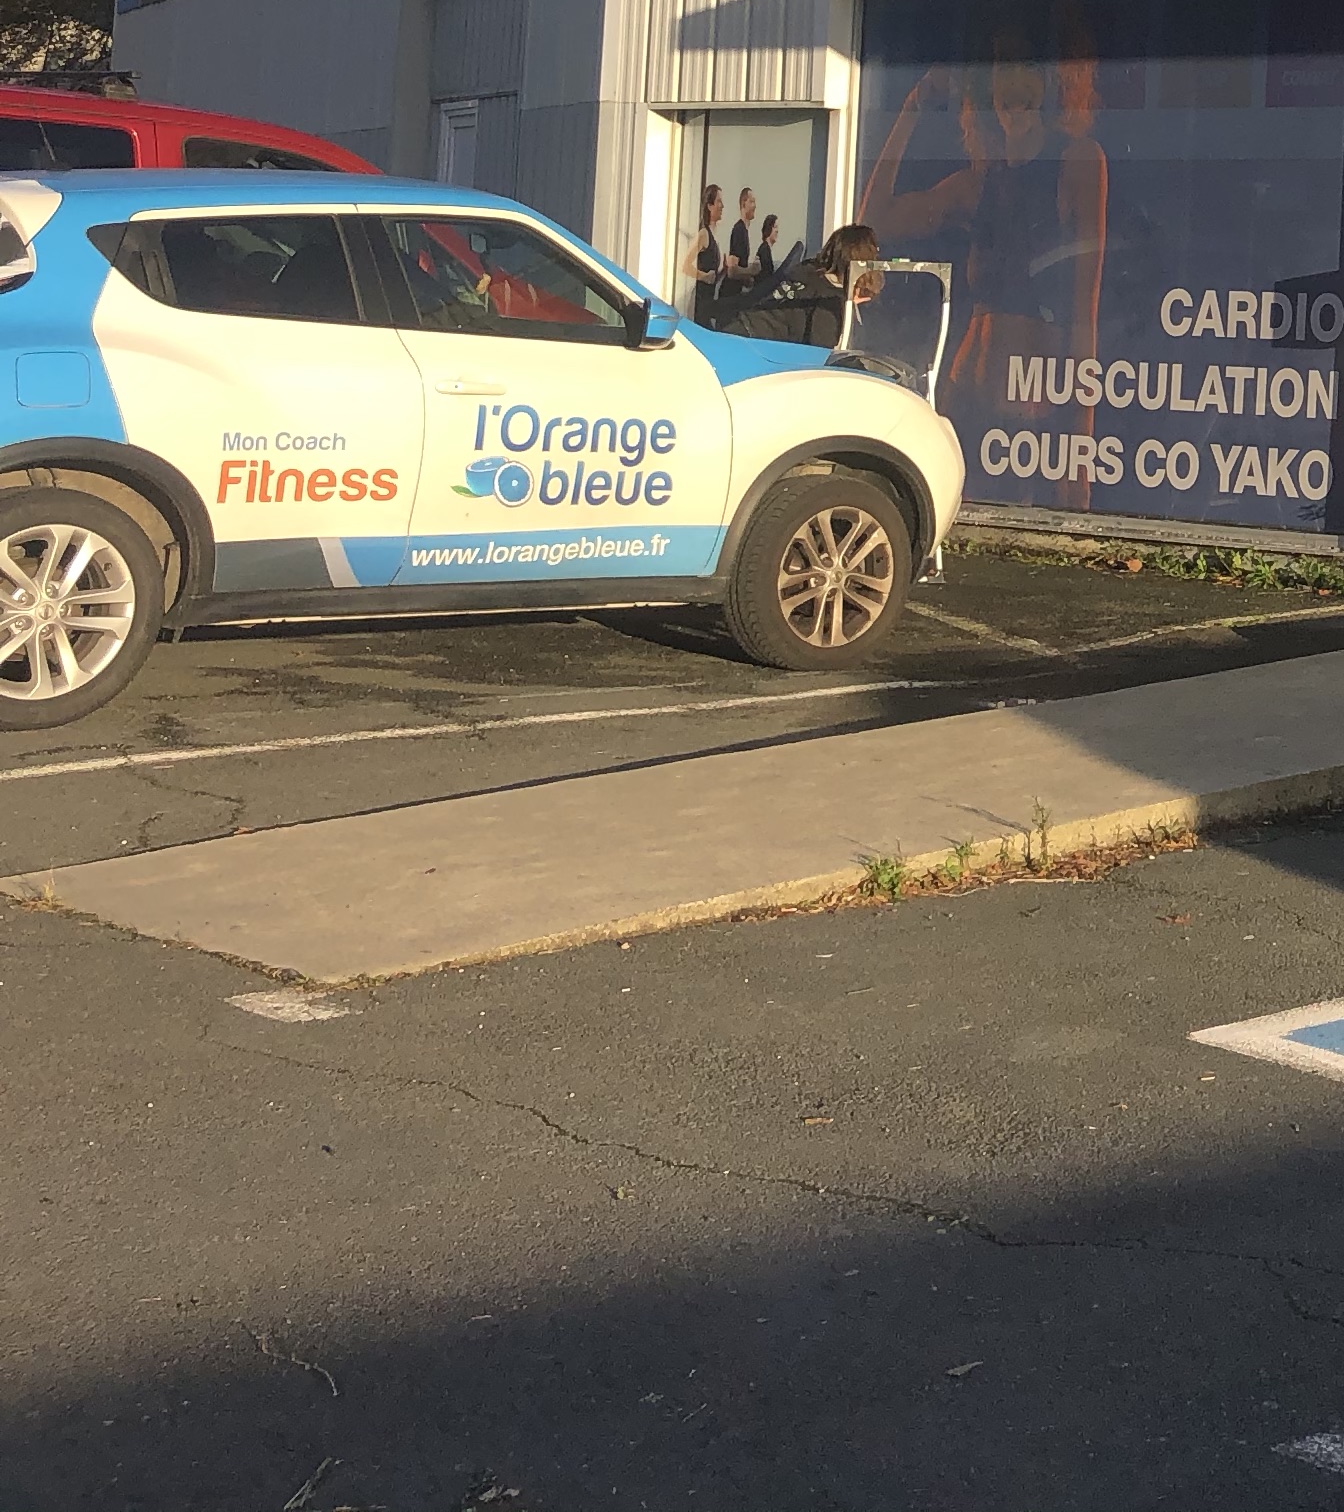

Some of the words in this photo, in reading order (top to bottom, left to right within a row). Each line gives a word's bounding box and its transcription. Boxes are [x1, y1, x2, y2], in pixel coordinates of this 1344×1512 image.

[1160, 287, 1344, 343] CARDIO
[1006, 355, 1339, 421] MUSCULATION
[222, 431, 267, 452] Mon
[274, 431, 346, 452] Coach
[474, 403, 678, 466] l'Orange
[216, 459, 399, 504] Fitness
[538, 460, 673, 507] bleue
[979, 428, 1124, 486] COURS
[1134, 438, 1199, 491] CO
[1209, 443, 1334, 501] YAKO
[411, 533, 671, 567] www.lorangebleue.fr
